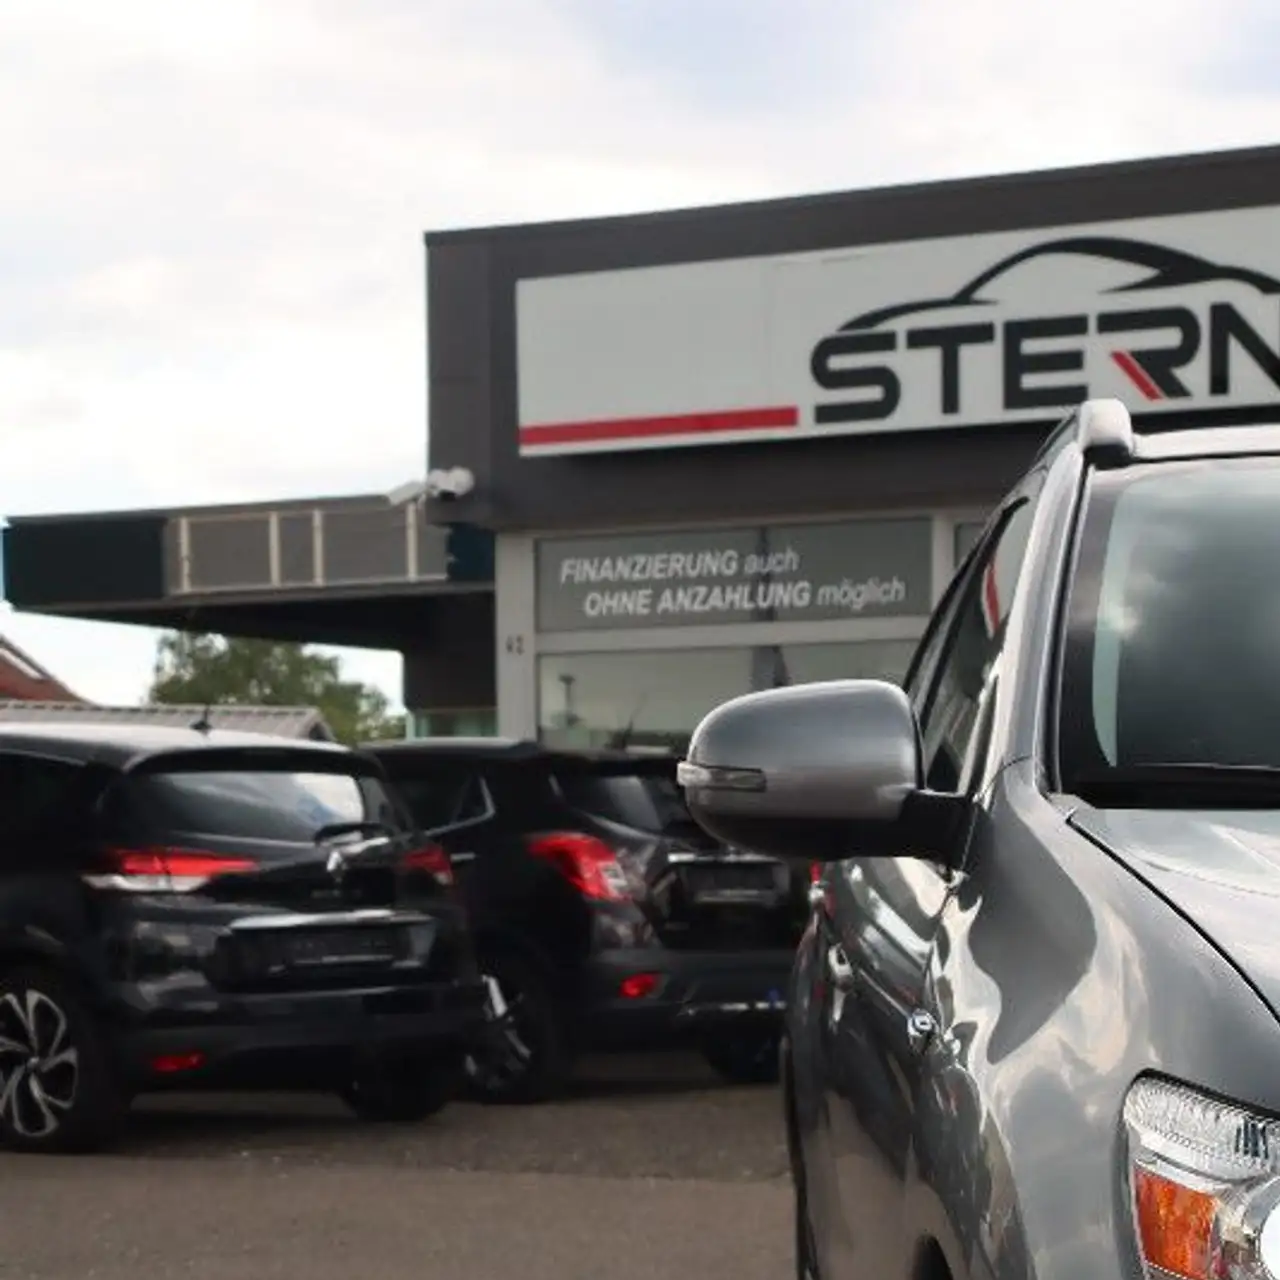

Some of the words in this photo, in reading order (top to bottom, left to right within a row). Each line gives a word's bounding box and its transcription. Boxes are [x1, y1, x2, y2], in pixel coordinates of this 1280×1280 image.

[560, 550, 739, 584] FINANZIERUNG
[744, 548, 799, 575] auch
[584, 588, 651, 617] OHNE
[657, 581, 811, 614] ANZAHLUNG
[817, 577, 906, 610] möglich
